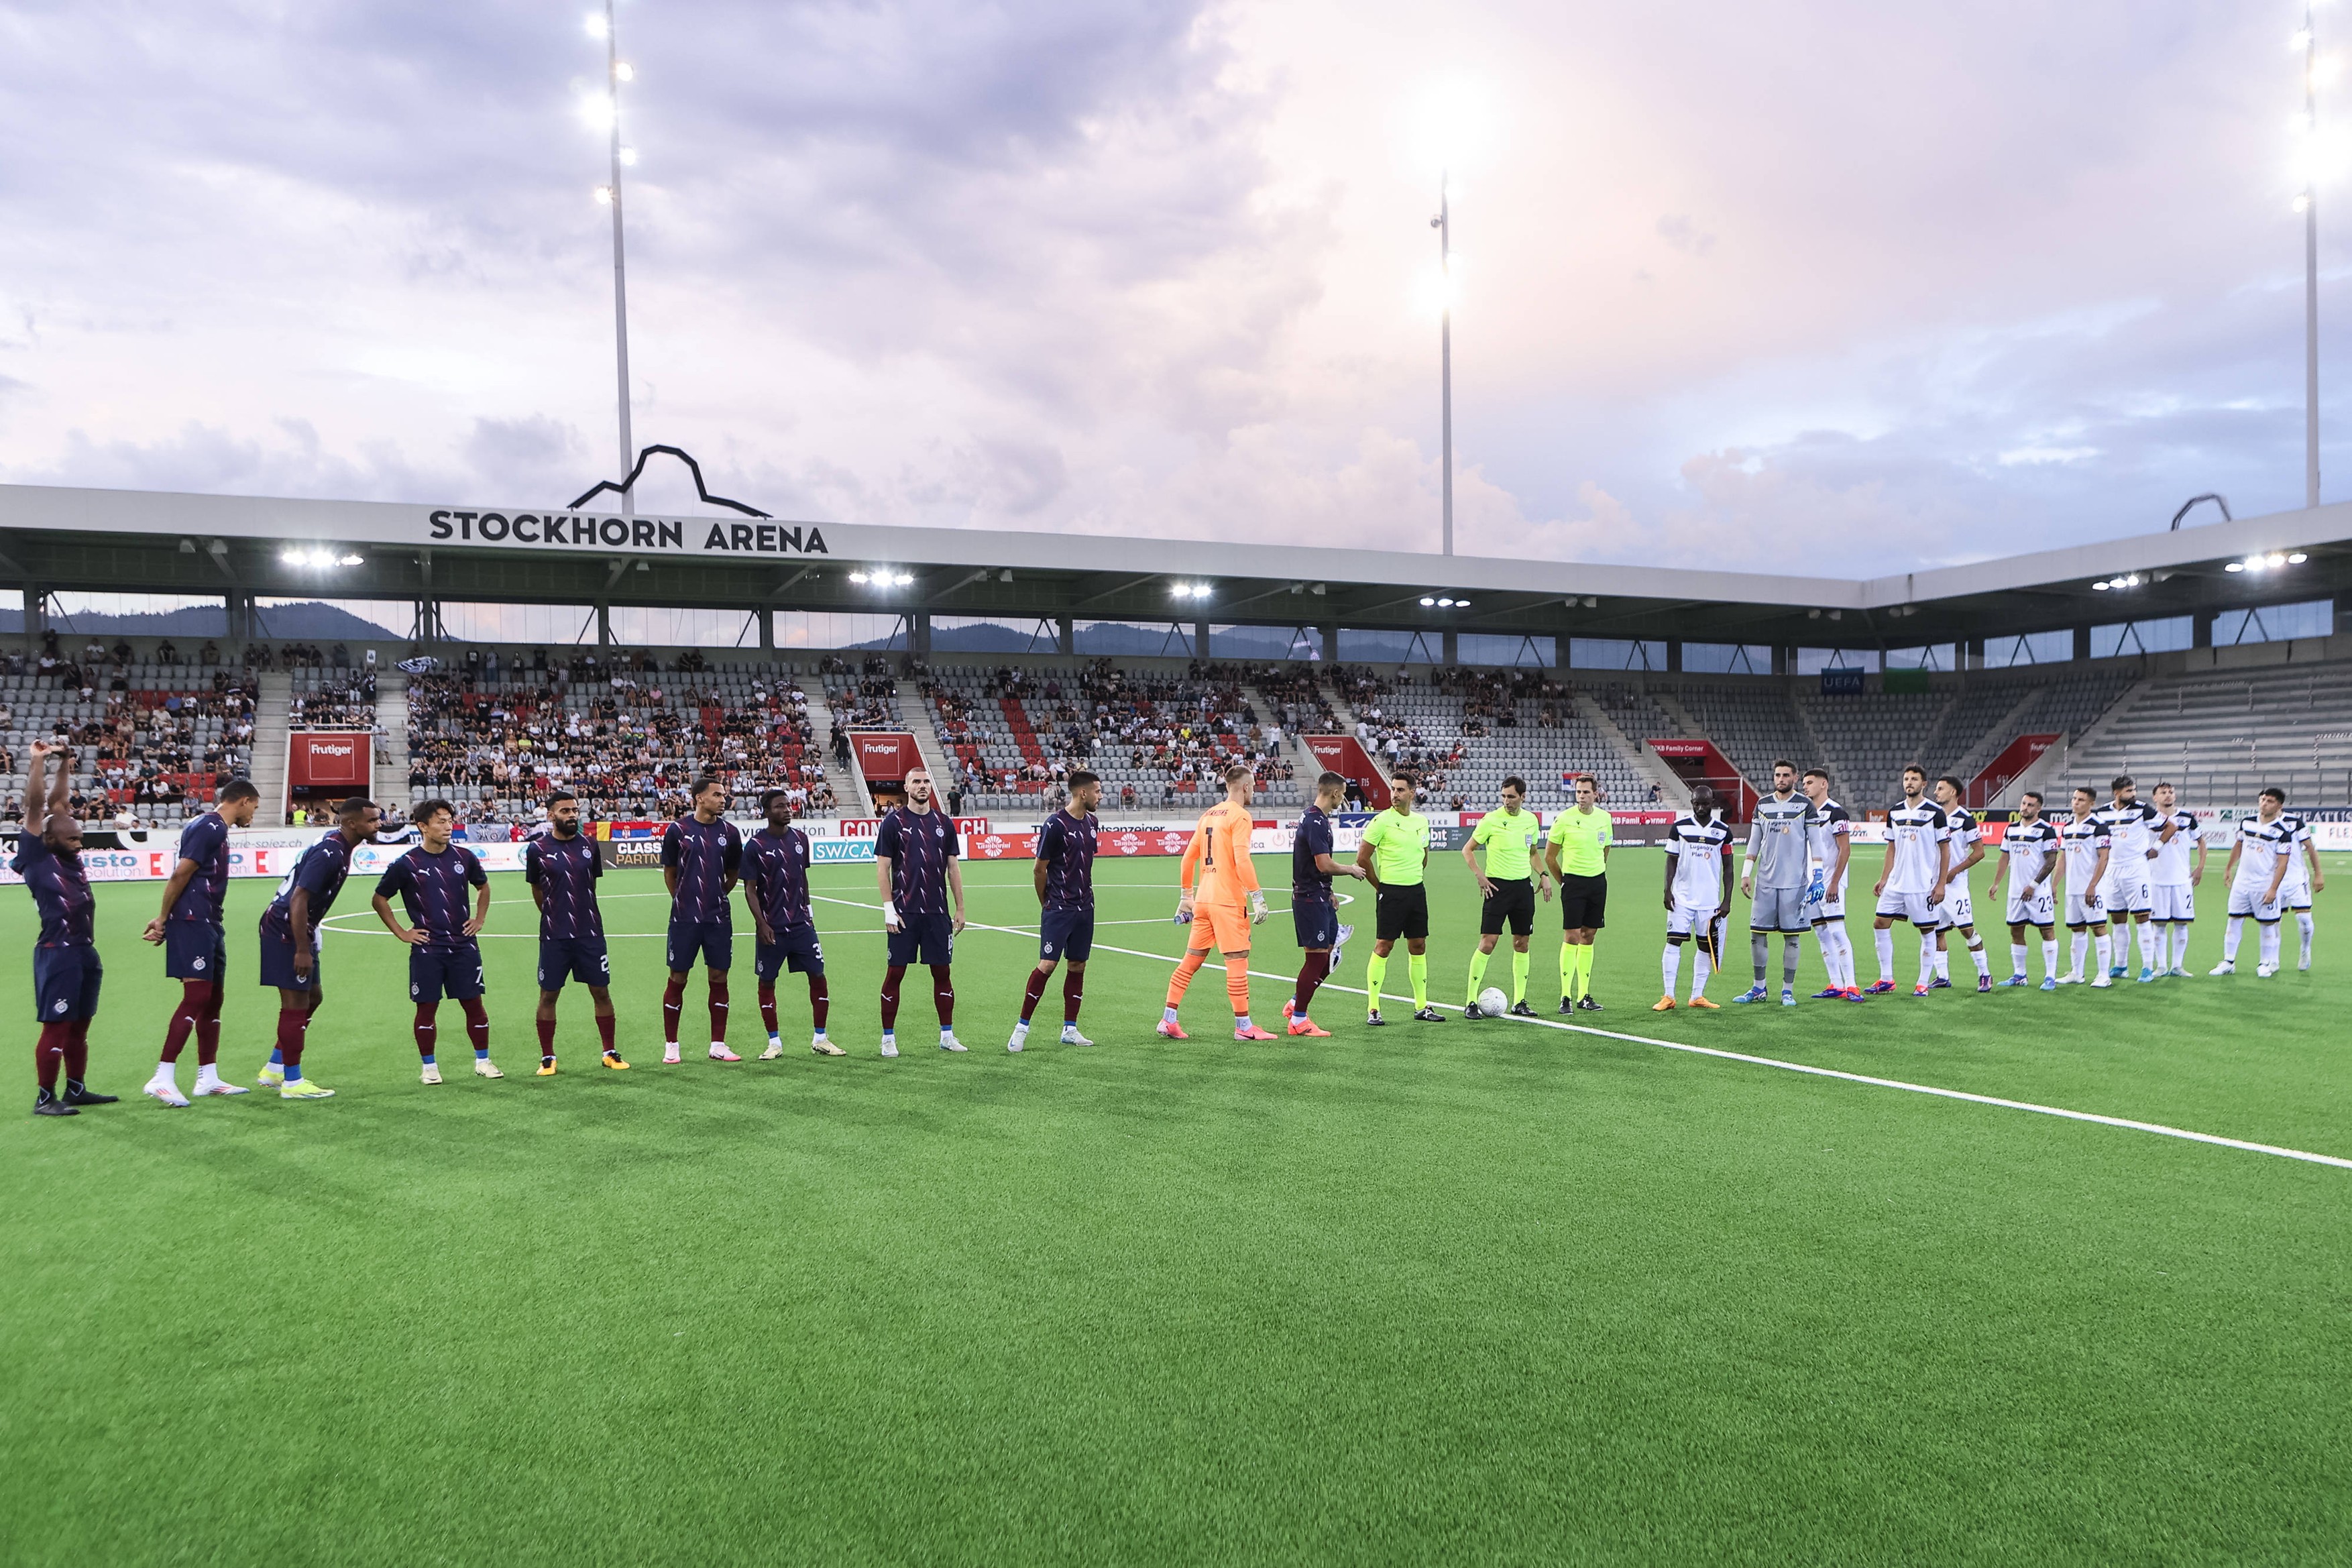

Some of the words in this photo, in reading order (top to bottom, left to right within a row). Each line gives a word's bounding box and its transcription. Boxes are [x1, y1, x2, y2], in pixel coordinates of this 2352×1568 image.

[429, 510, 683, 549] STOCKHORN
[704, 523, 828, 553] ARENA
[1824, 676, 1860, 688] UEFA
[311, 744, 352, 757] Frutiger
[864, 744, 897, 754] Frutiger
[1314, 745, 1341, 755] Frutiger
[1666, 745, 1683, 753] Family
[1361, 777, 1370, 787] F15
[1622, 817, 1640, 825] Famil
[617, 842, 663, 854] CLASS
[1205, 827, 1213, 865] 1
[616, 854, 661, 864] PARTN
[2141, 884, 2148, 899] 6
[1956, 899, 1970, 915] 25
[2038, 895, 2053, 913] 23
[475, 966, 483, 984] 7
